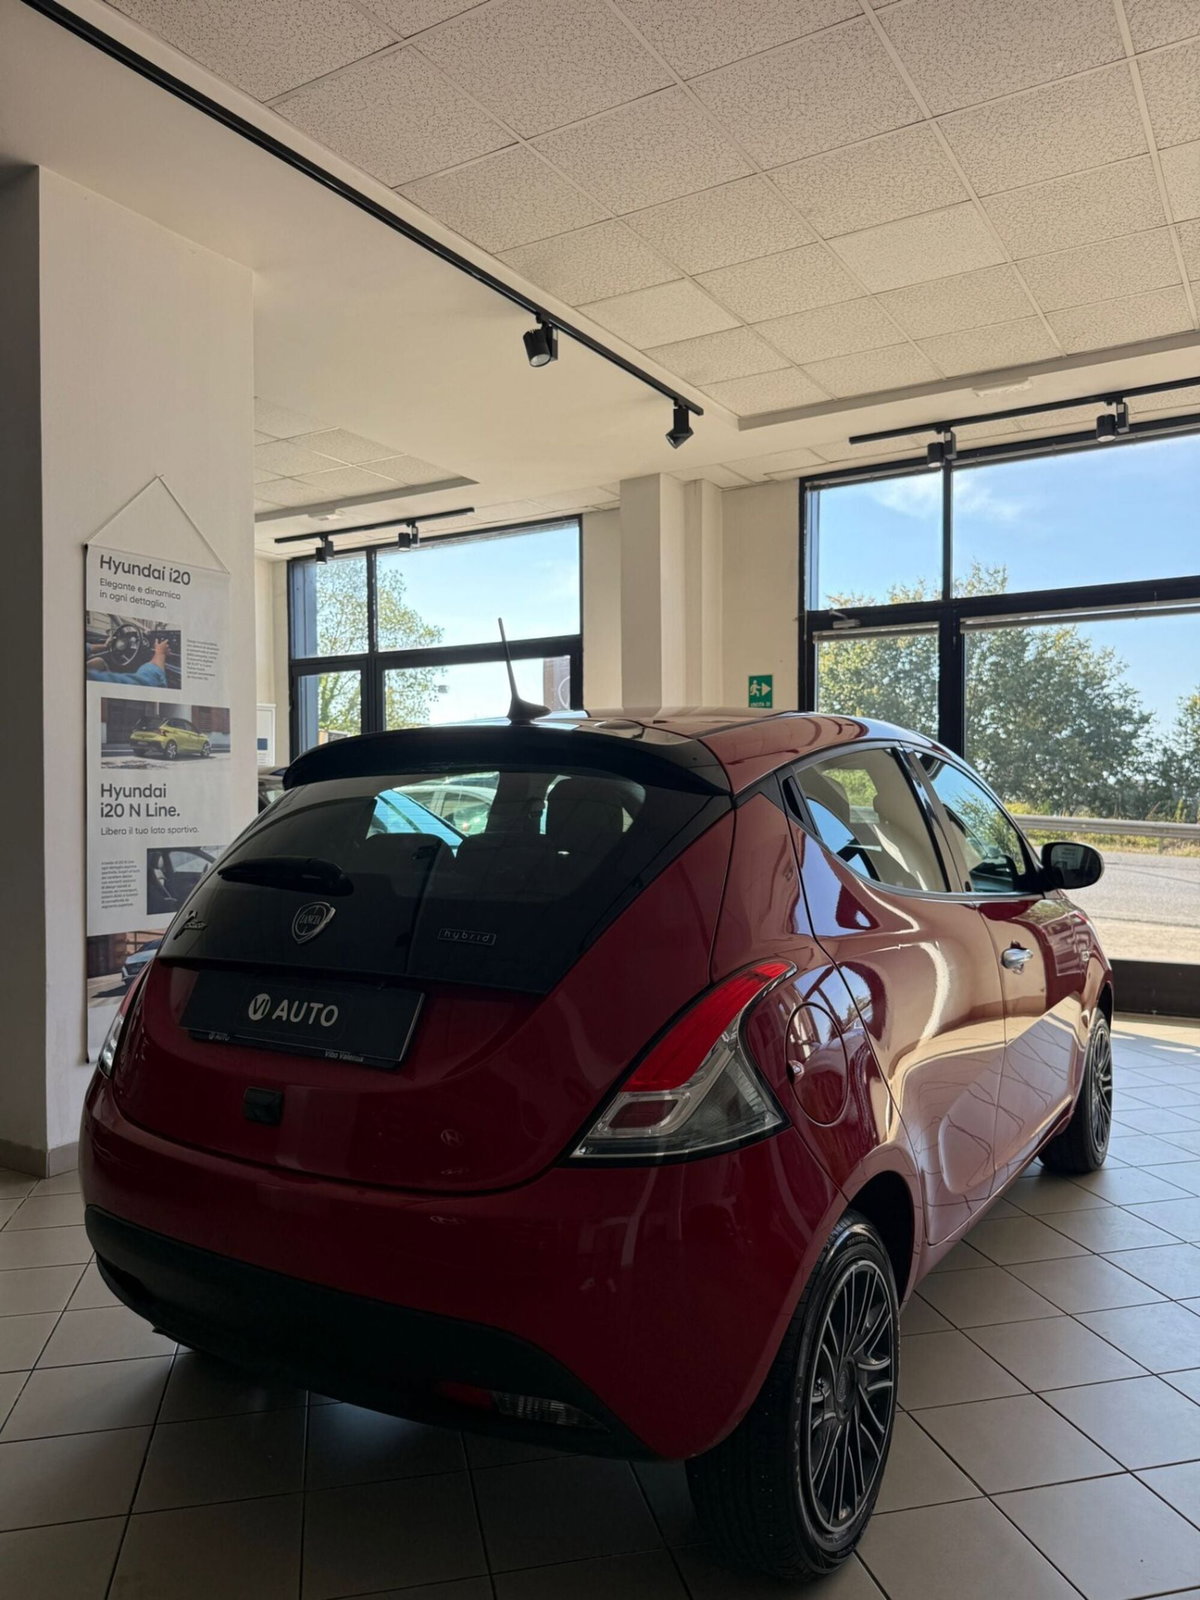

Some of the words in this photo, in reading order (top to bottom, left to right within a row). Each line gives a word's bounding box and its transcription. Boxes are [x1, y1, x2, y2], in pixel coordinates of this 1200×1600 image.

[100, 554, 166, 581] Hyundai
[169, 568, 191, 586] i20
[100, 578, 136, 592] Elegante
[144, 586, 181, 600] dinamica
[99, 590, 107, 598] in
[109, 593, 128, 603] ogni
[129, 595, 167, 609] dettaglio.
[101, 783, 167, 801] Hyundai
[100, 802, 125, 818] i20
[129, 803, 141, 817] N
[146, 802, 180, 817] Line.
[100, 827, 127, 836] Libera
[129, 827, 134, 835] il
[150, 826, 166, 834] lato
[167, 825, 199, 835] sportivo.
[445, 930, 490, 942] hybrid
[271, 999, 339, 1027] AUTO
